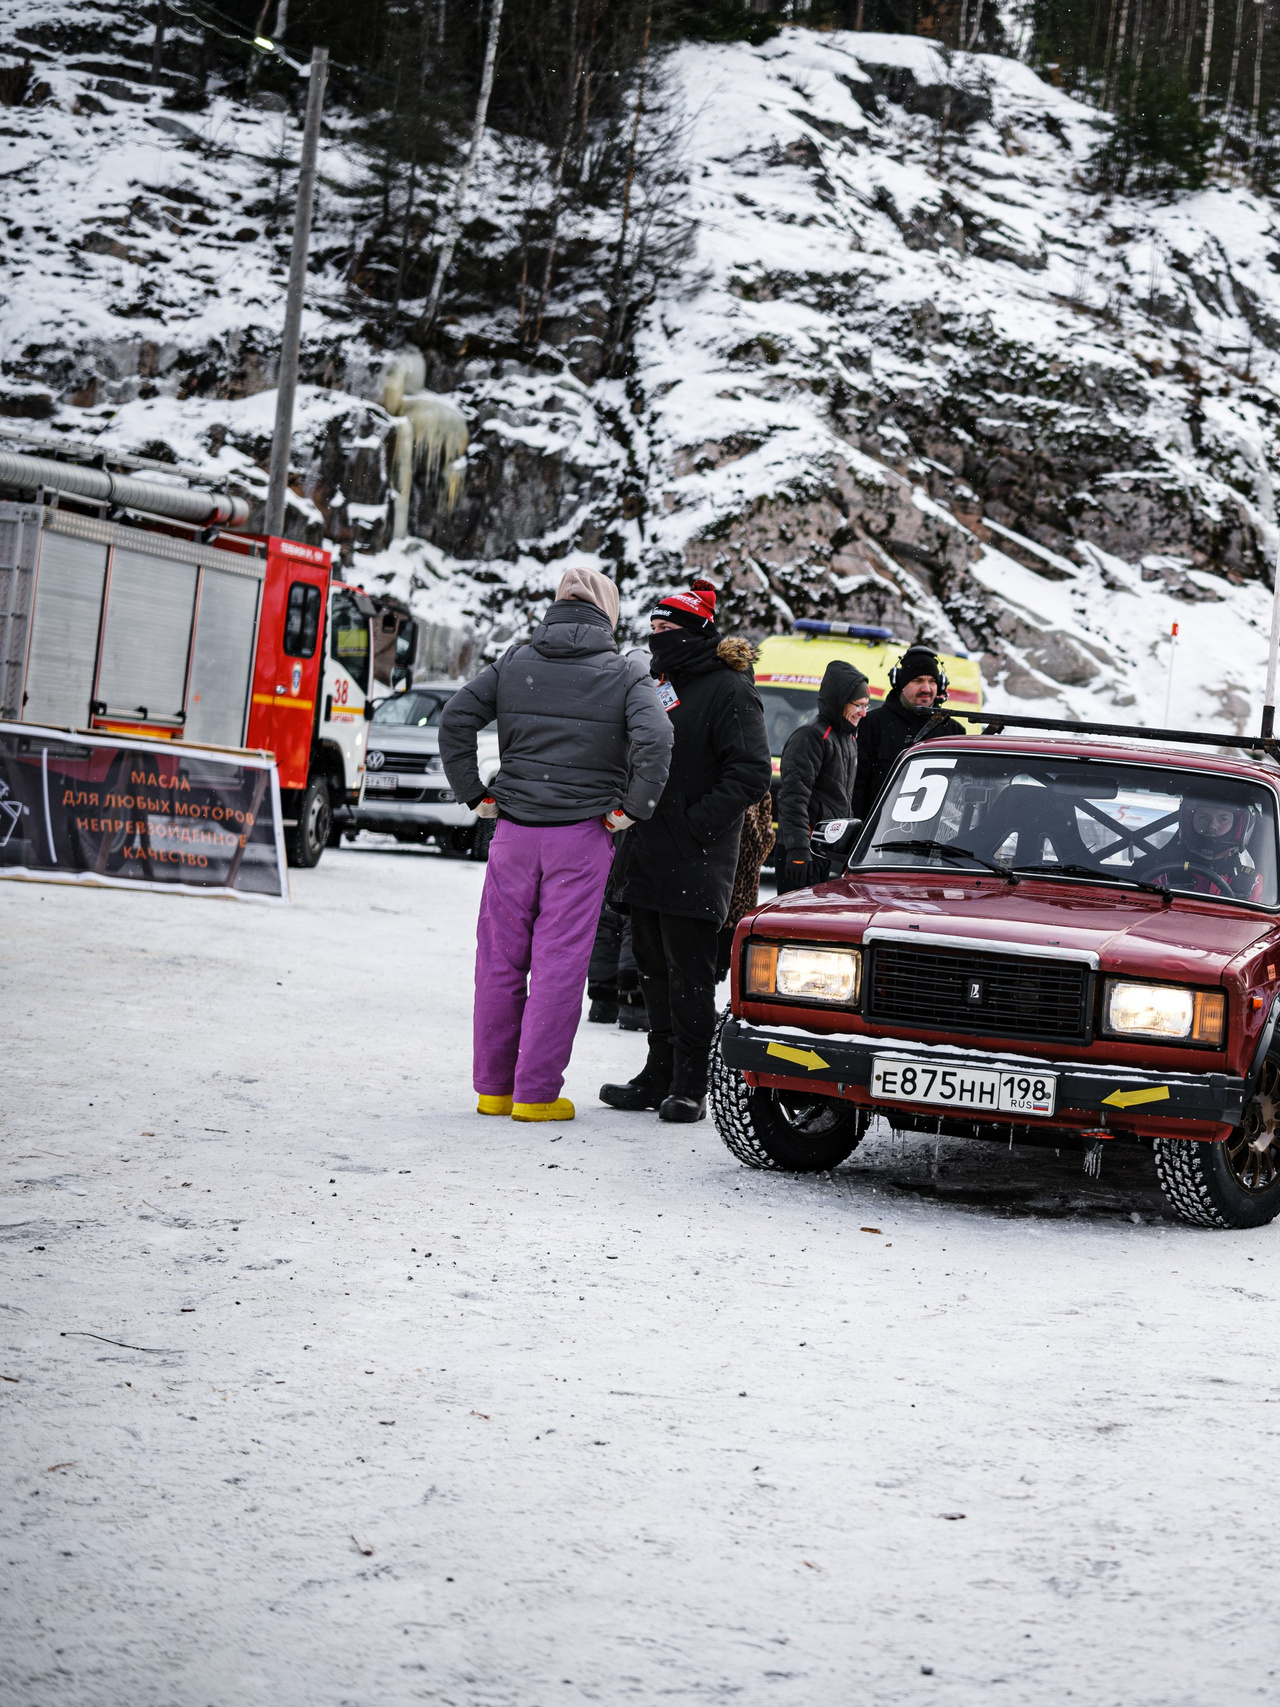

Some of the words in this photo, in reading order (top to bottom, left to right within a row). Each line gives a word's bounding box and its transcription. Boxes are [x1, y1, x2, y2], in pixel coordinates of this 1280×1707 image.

[333, 679, 349, 705] 38
[131, 771, 191, 792] МАСЛА
[892, 758, 958, 822] 5
[62, 789, 99, 807] ДЛЯ
[103, 793, 170, 814] ЛЮБЫХ
[175, 801, 255, 827] МОТОРОВ
[77, 817, 248, 849] НЕПРЕВЗОЙДЕННОЕ
[123, 846, 209, 868] КАЧЕСТВО
[882, 1067, 995, 1105] Е875НН
[1003, 1077, 1046, 1101] 198
[1011, 1100, 1032, 1109] RUS
